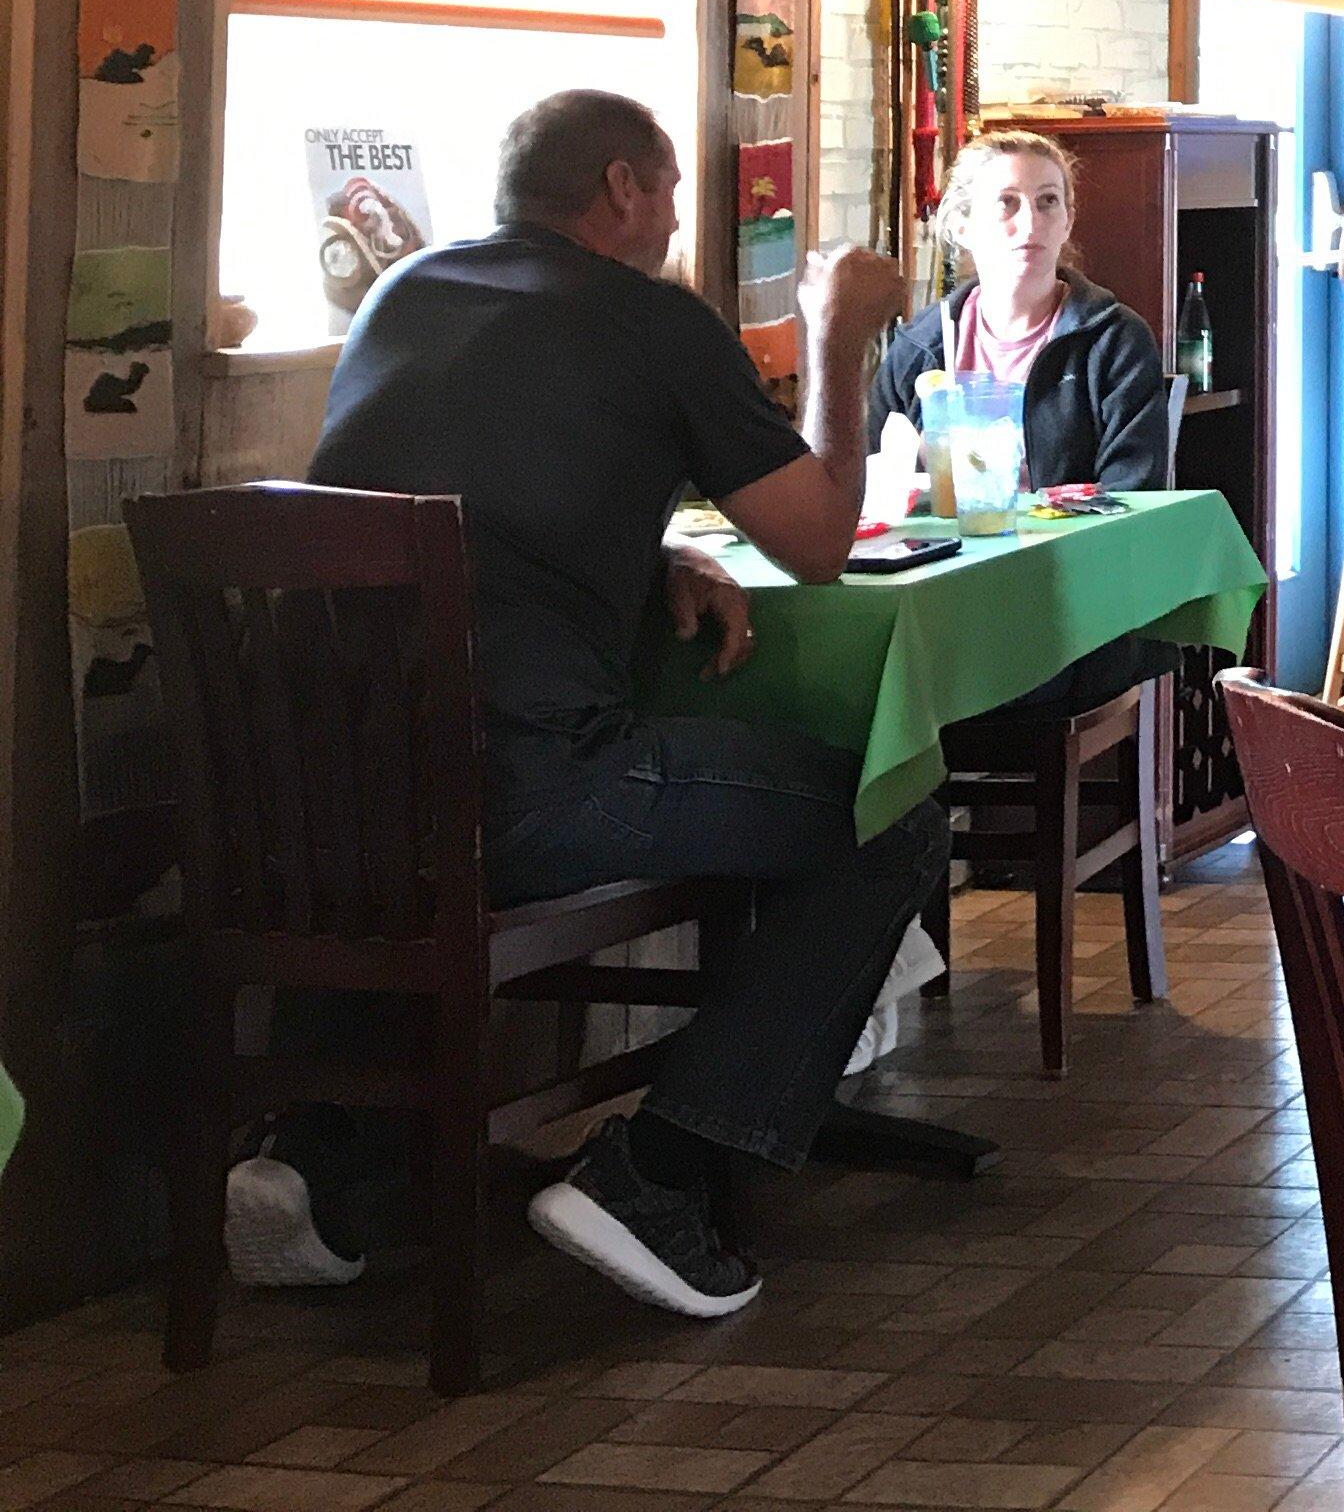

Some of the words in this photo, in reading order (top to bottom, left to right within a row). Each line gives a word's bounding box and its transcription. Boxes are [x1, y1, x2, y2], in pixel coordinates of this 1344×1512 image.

[304, 128, 339, 144] ONLY
[342, 128, 384, 145] ACCEPT
[325, 144, 365, 171] THE
[369, 144, 413, 171] BEST
